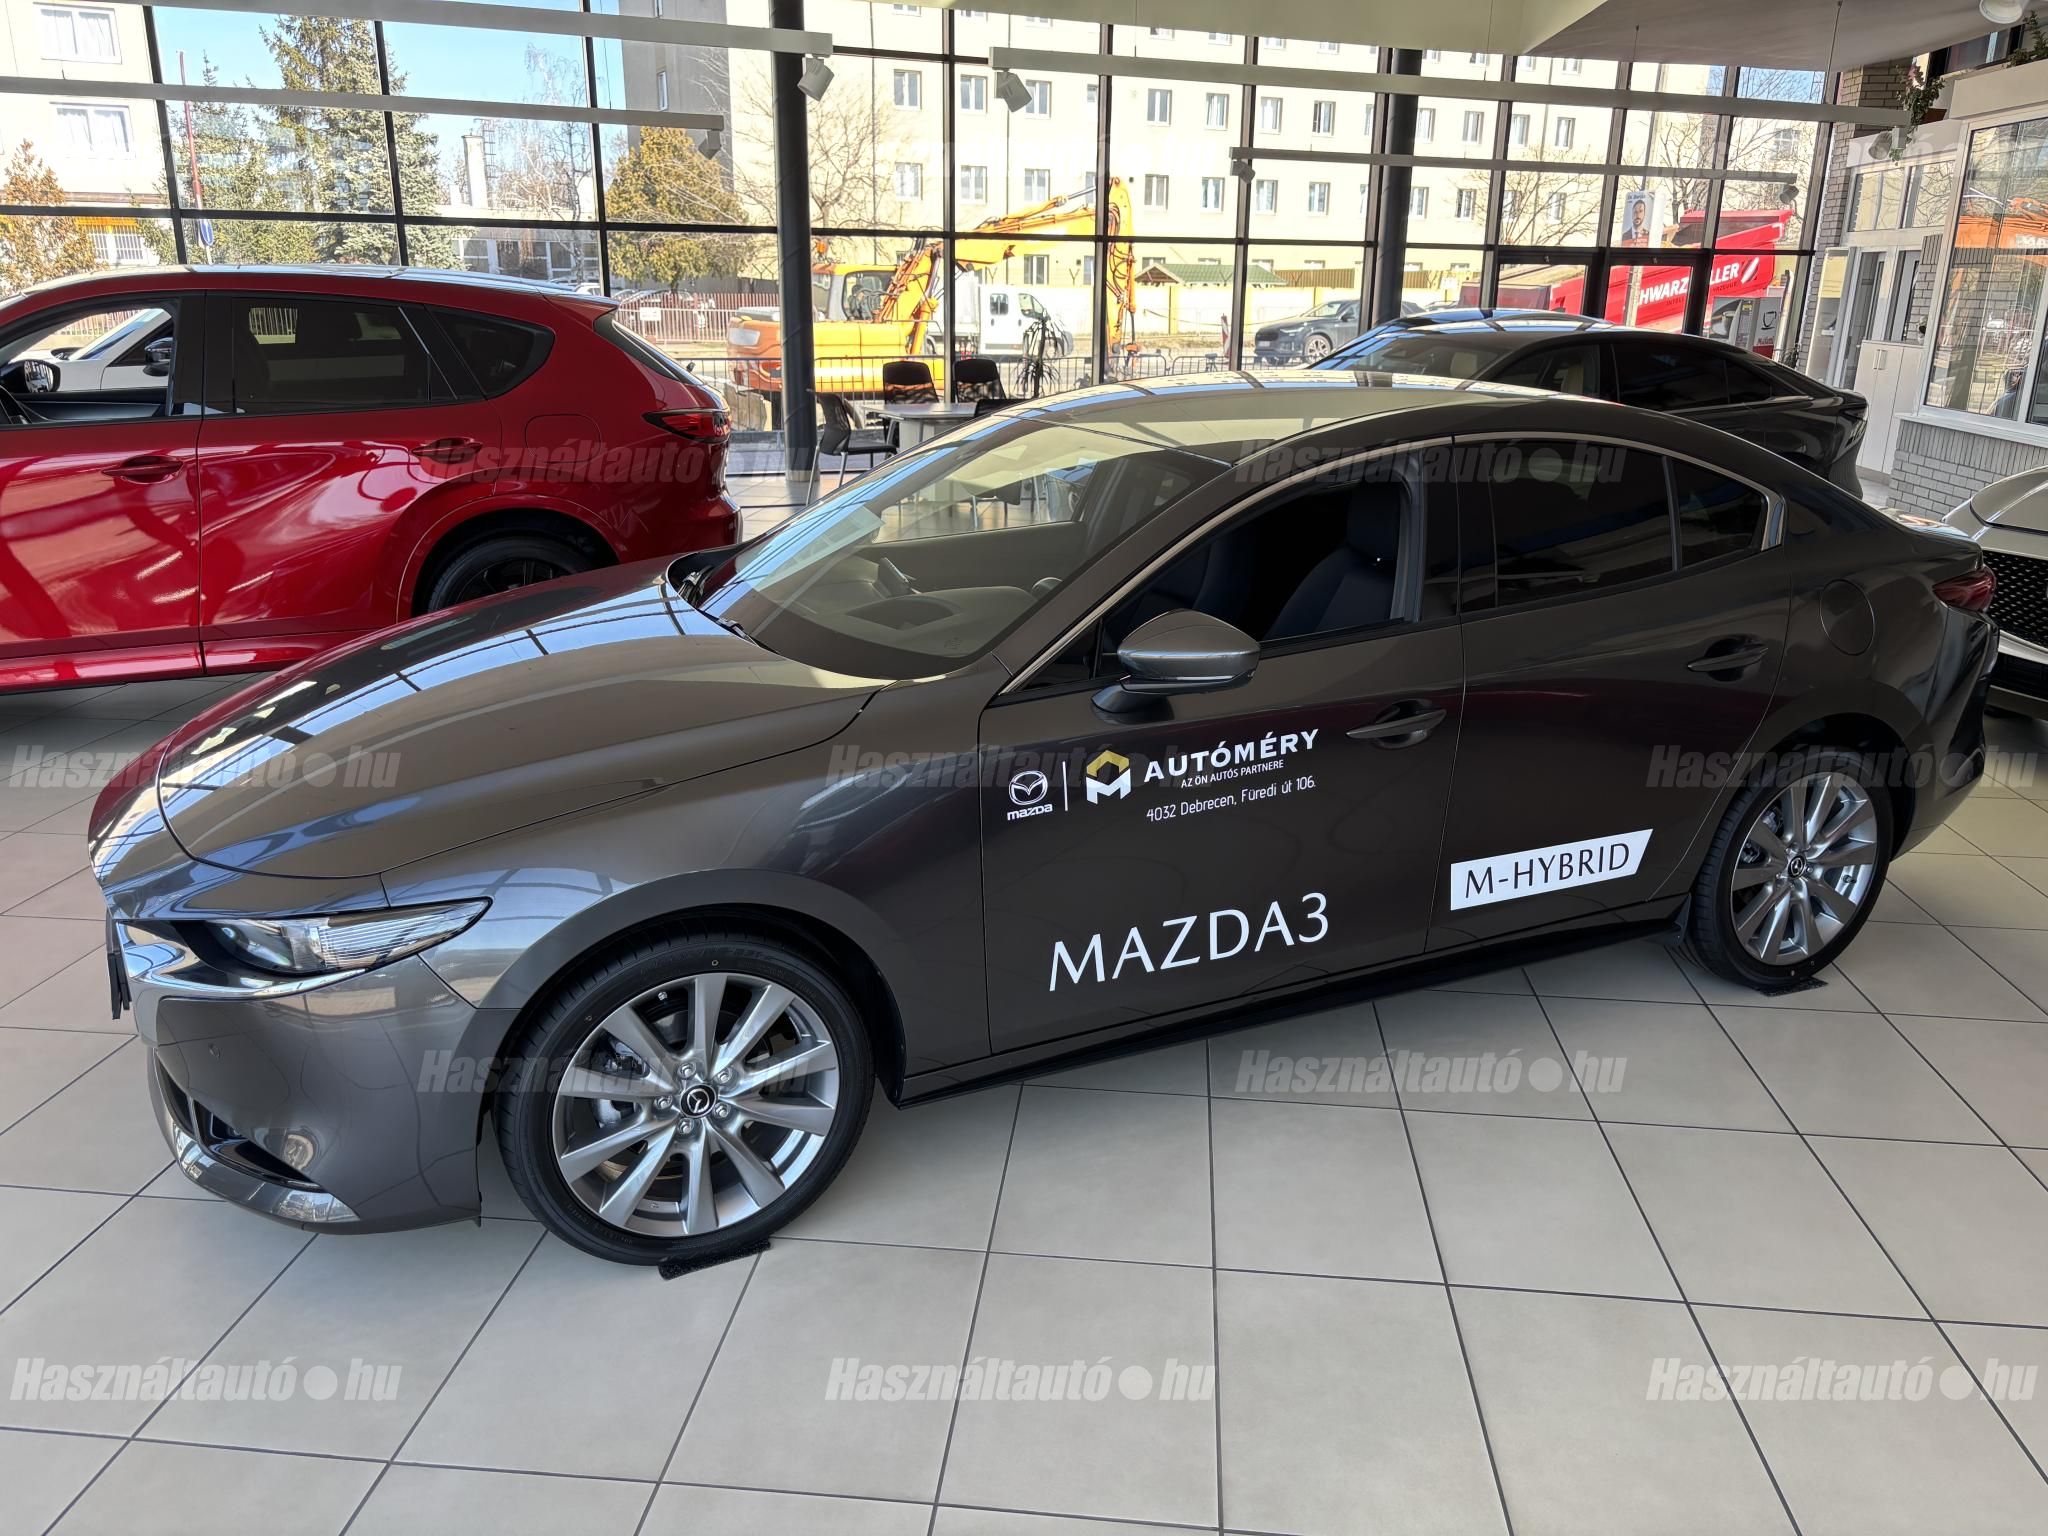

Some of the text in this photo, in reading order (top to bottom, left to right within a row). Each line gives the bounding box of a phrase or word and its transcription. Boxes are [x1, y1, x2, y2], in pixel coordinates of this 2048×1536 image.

[1144, 728, 1319, 782] AUTÓMÉRY
[1181, 759, 1284, 789] AZ ÖN AUTÓS PARTNERE
[1146, 775, 1316, 822] 4032 Debrecen, Füredi út 106.
[1465, 842, 1630, 899] M-HYBRID
[1049, 892, 1329, 992] MAZDA3
